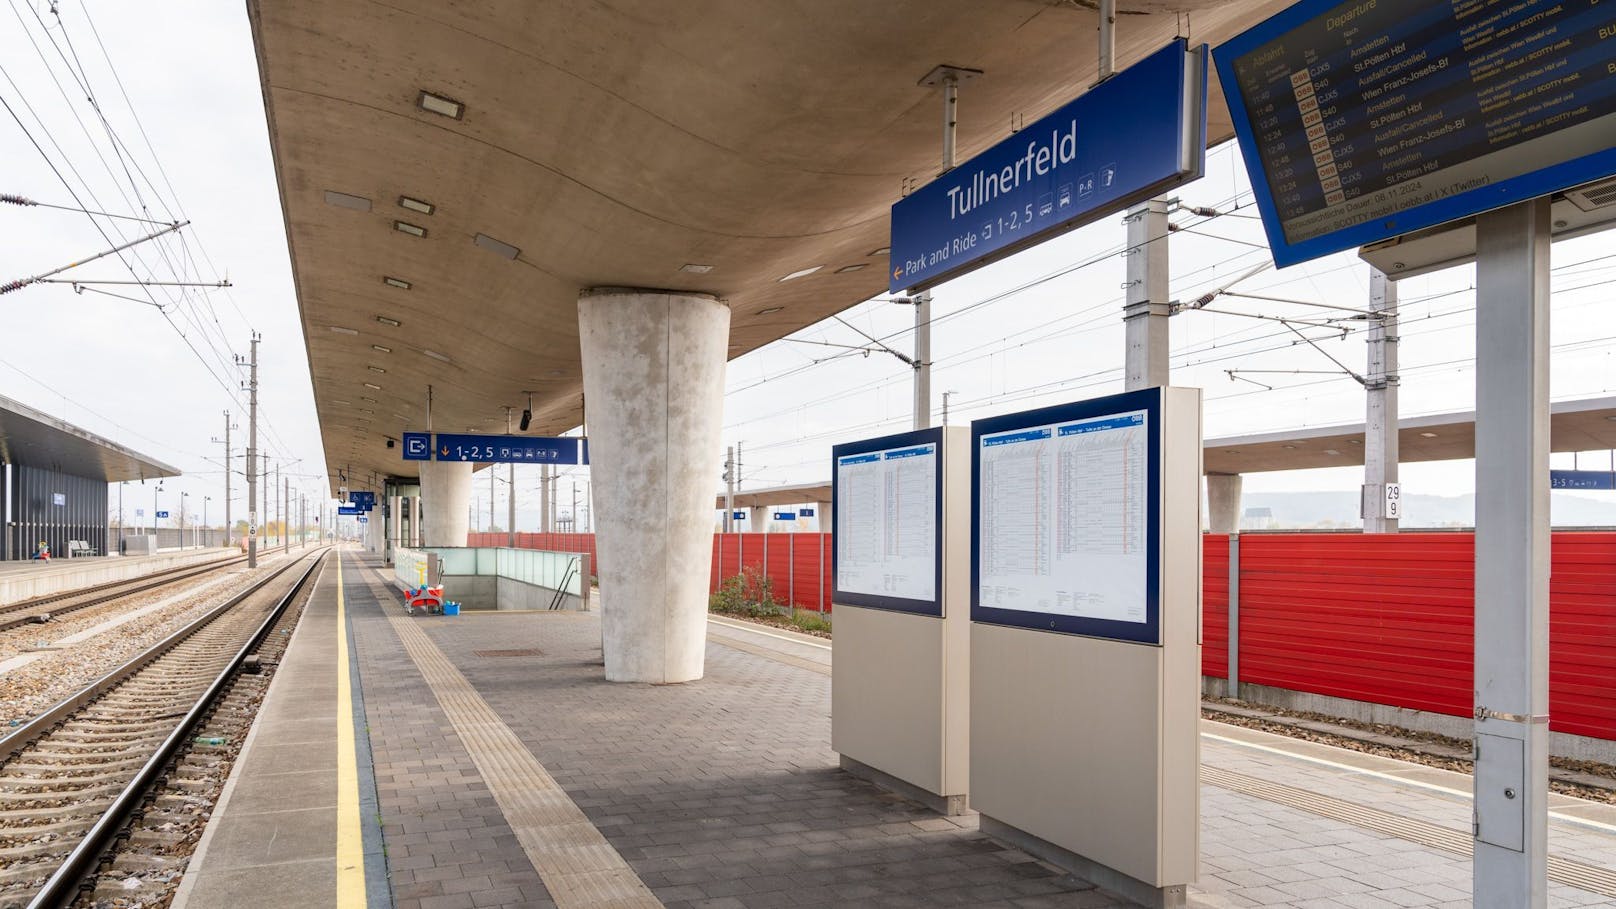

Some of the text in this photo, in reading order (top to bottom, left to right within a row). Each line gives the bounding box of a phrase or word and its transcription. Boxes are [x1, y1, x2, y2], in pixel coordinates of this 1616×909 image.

[1326, 0, 1377, 31] Departure
[1520, 13, 1545, 27] SCOTTY
[1310, 63, 1329, 76] CJX5
[1350, 34, 1389, 58] Amstetten
[1314, 79, 1328, 90] S40
[1391, 43, 1405, 55] Hbf
[1529, 46, 1553, 60] SCOTTY
[1318, 90, 1337, 103] CJX5
[1322, 106, 1336, 117] S40
[1362, 86, 1382, 100] Wien
[1383, 58, 1448, 91] Franz-Josefs-Bf
[1537, 79, 1562, 92] SCOTTY
[1326, 118, 1345, 130] CJX5
[1366, 93, 1405, 114] Amstetten
[1330, 133, 1344, 143] S40
[1407, 102, 1422, 114] Hbf
[1546, 112, 1571, 125] SCOTTY
[1334, 145, 1353, 157] CJX5
[1338, 160, 1352, 170] S40
[1378, 143, 1398, 156] Wien
[1399, 119, 1465, 148] Franz-Josefs-Bf
[947, 119, 1076, 219] Tullnerfeld
[1341, 172, 1361, 183] CJX5
[1381, 151, 1421, 170] Amstetten
[1345, 187, 1360, 197] S40
[1423, 161, 1438, 171] Hbf
[1334, 212, 1369, 228] SCOTTY
[1450, 174, 1490, 194] (Twitter)
[905, 254, 927, 276] Park
[929, 241, 950, 265] and
[953, 231, 977, 256] Ride
[1025, 203, 1033, 223] 5
[486, 446, 494, 458] 5
[1387, 486, 1400, 500] 29
[1390, 502, 1397, 516] 9
